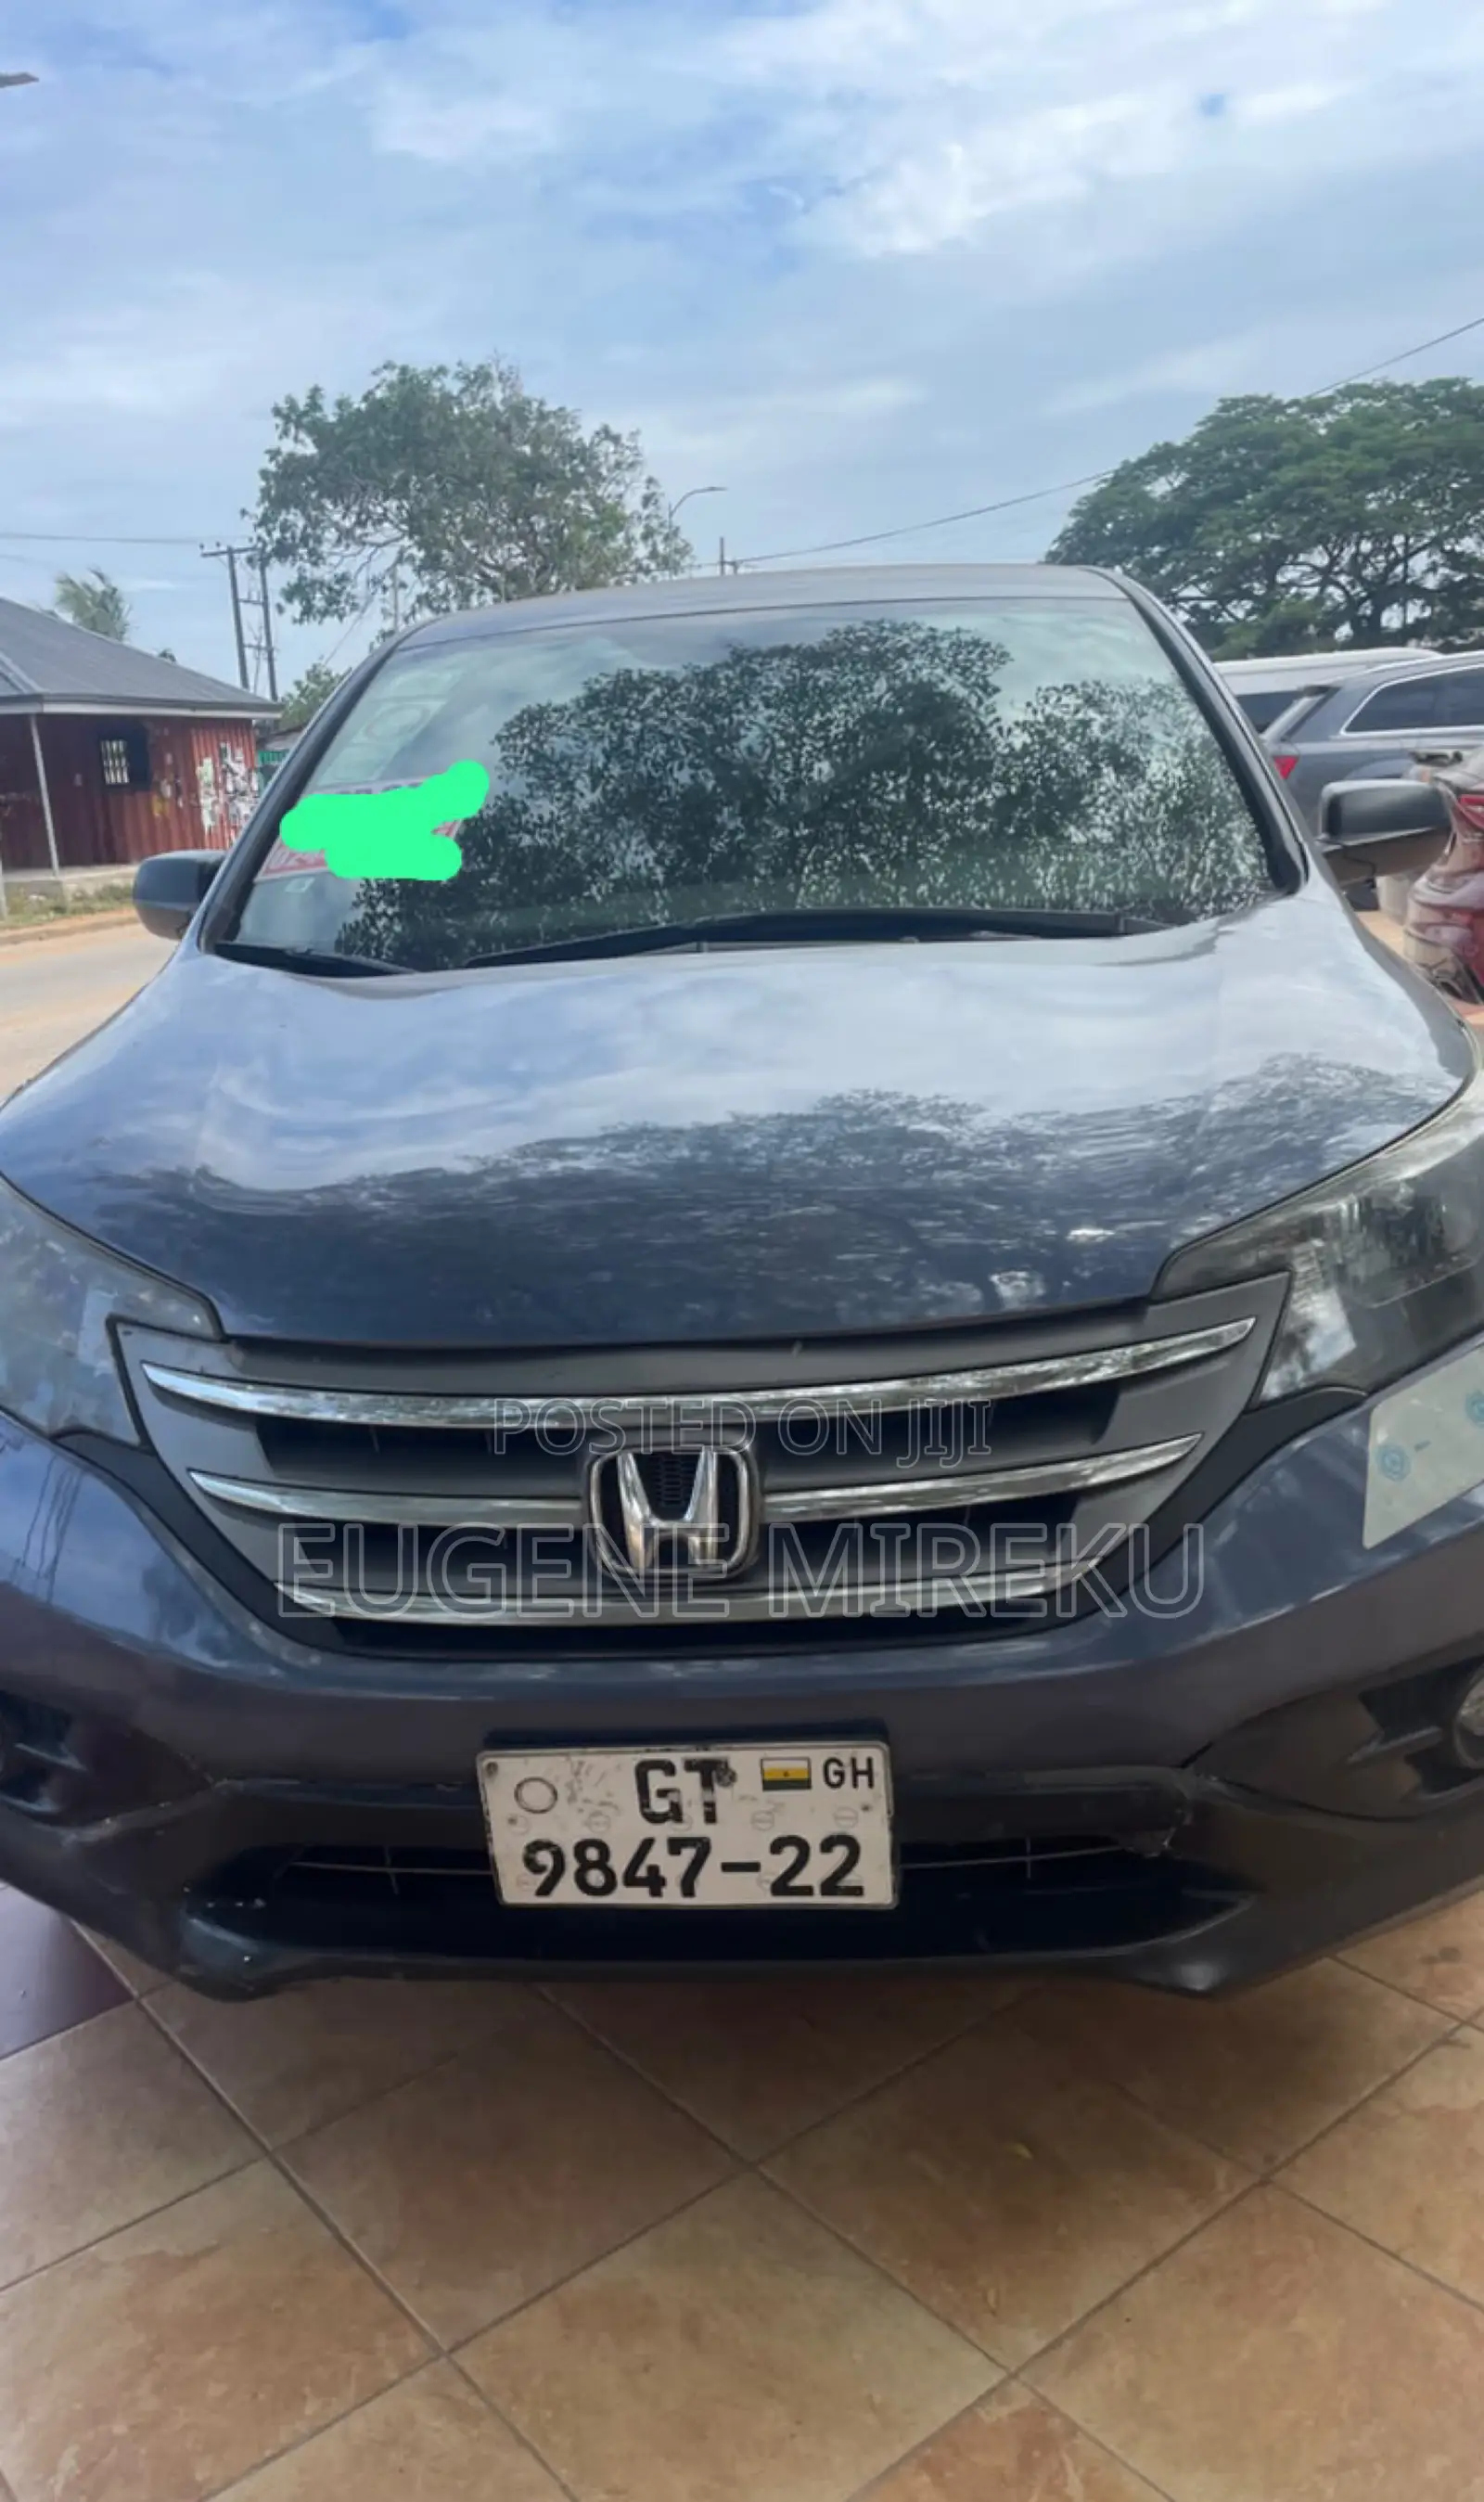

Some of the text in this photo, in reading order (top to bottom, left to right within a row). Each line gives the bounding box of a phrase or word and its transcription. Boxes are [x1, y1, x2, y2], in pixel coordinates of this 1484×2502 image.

[634, 1758, 729, 1824] GT
[822, 1756, 876, 1790] GH
[522, 1834, 864, 1898] 9847-22
